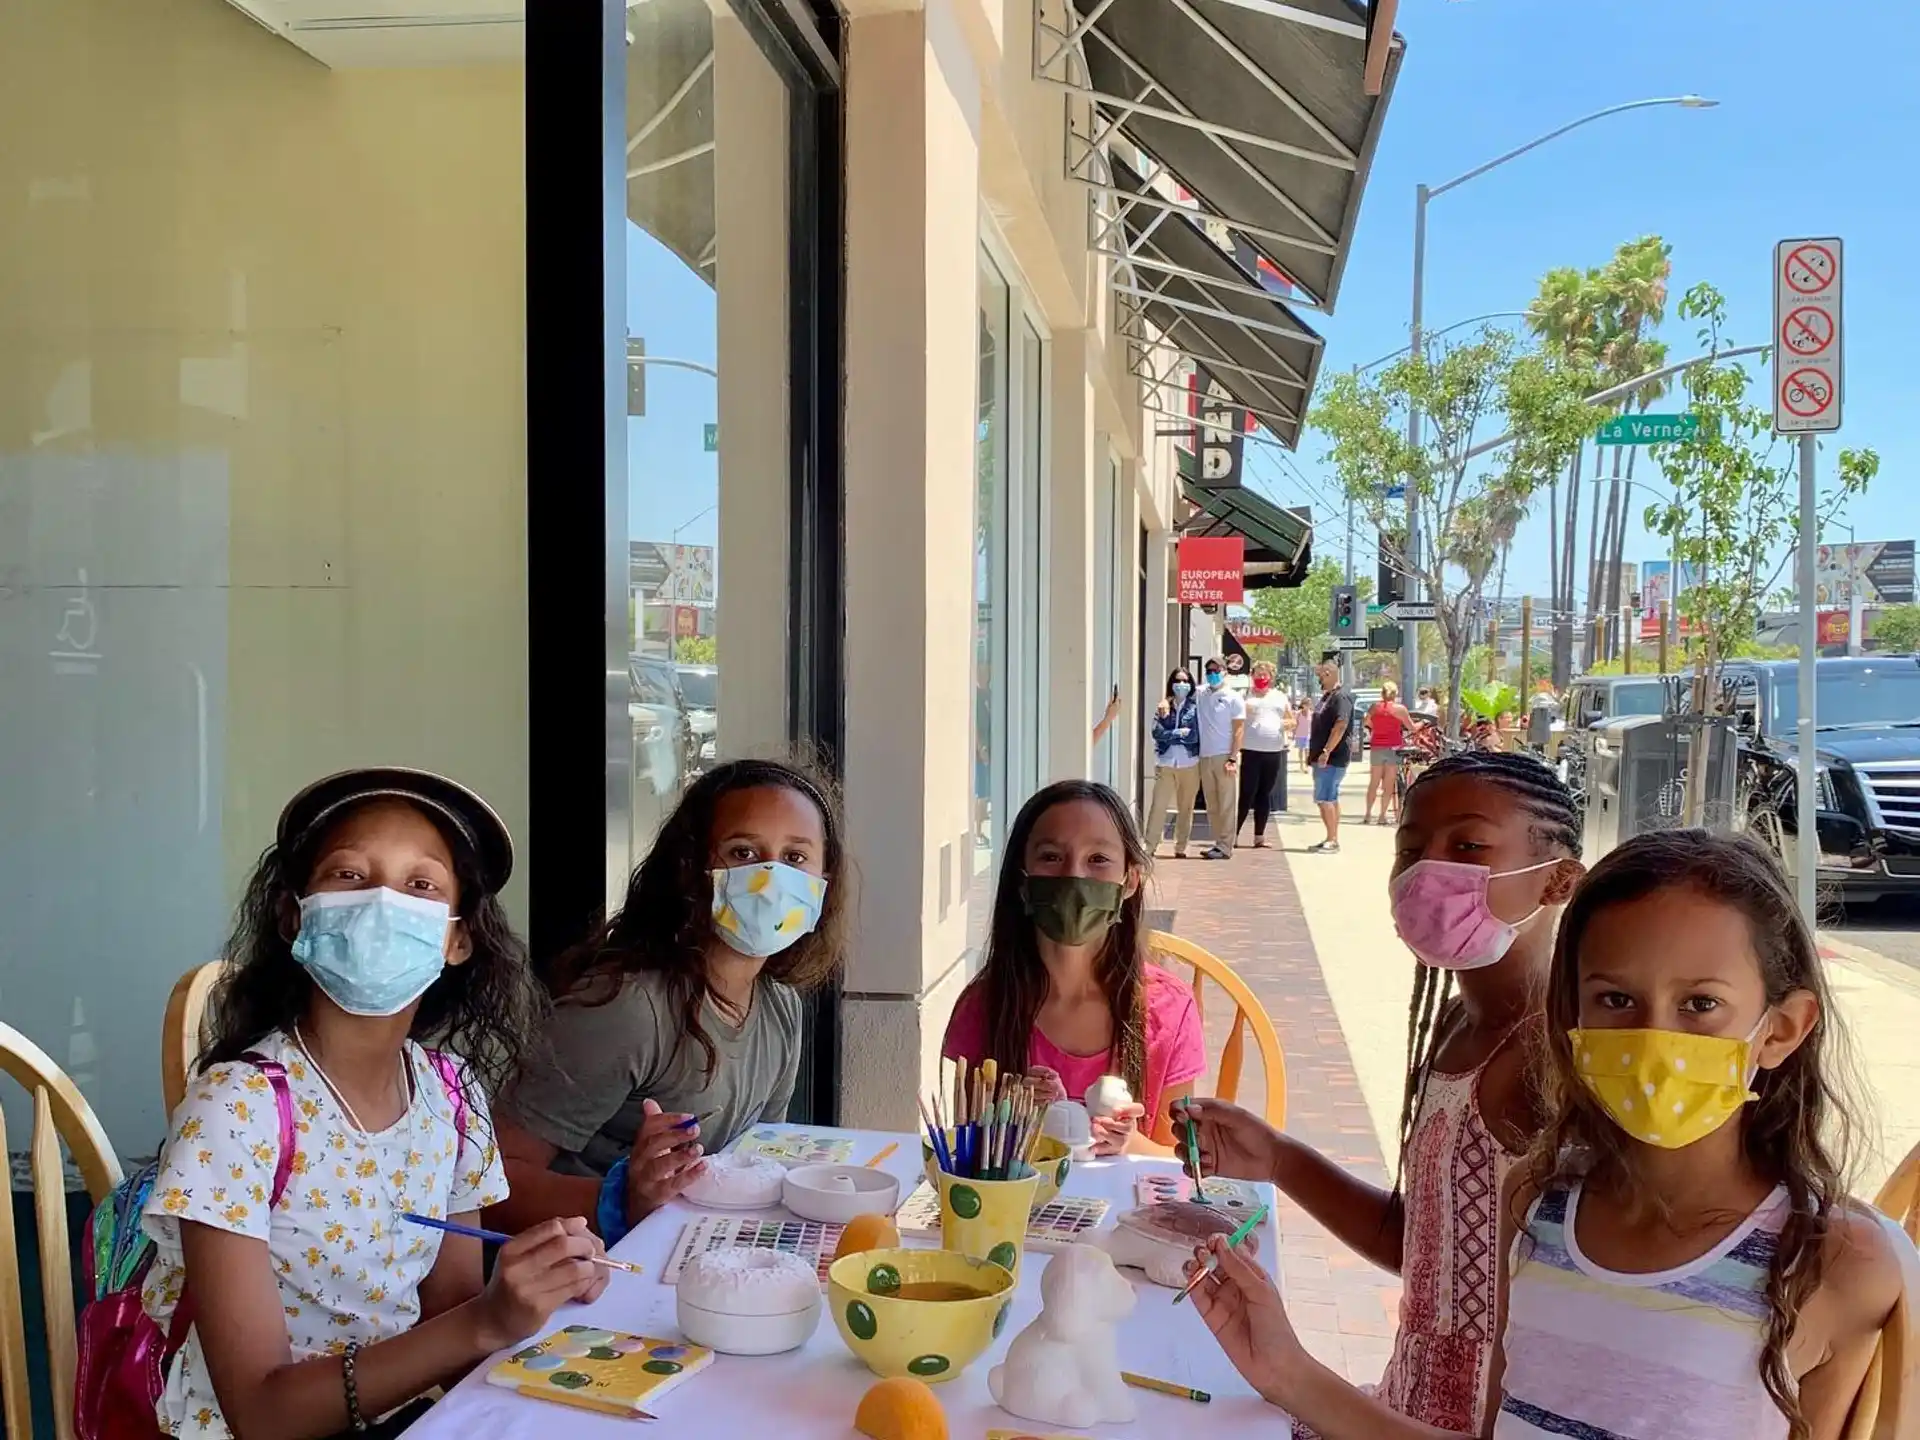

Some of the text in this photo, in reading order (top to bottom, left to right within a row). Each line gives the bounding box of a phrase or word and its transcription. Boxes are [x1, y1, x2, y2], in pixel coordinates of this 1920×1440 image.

[1601, 424, 1622, 438] La
[1632, 422, 1683, 437] Verne
[1181, 570, 1240, 580] EUROPEAN
[1181, 580, 1206, 589] WAX
[1181, 590, 1223, 600] CENTER
